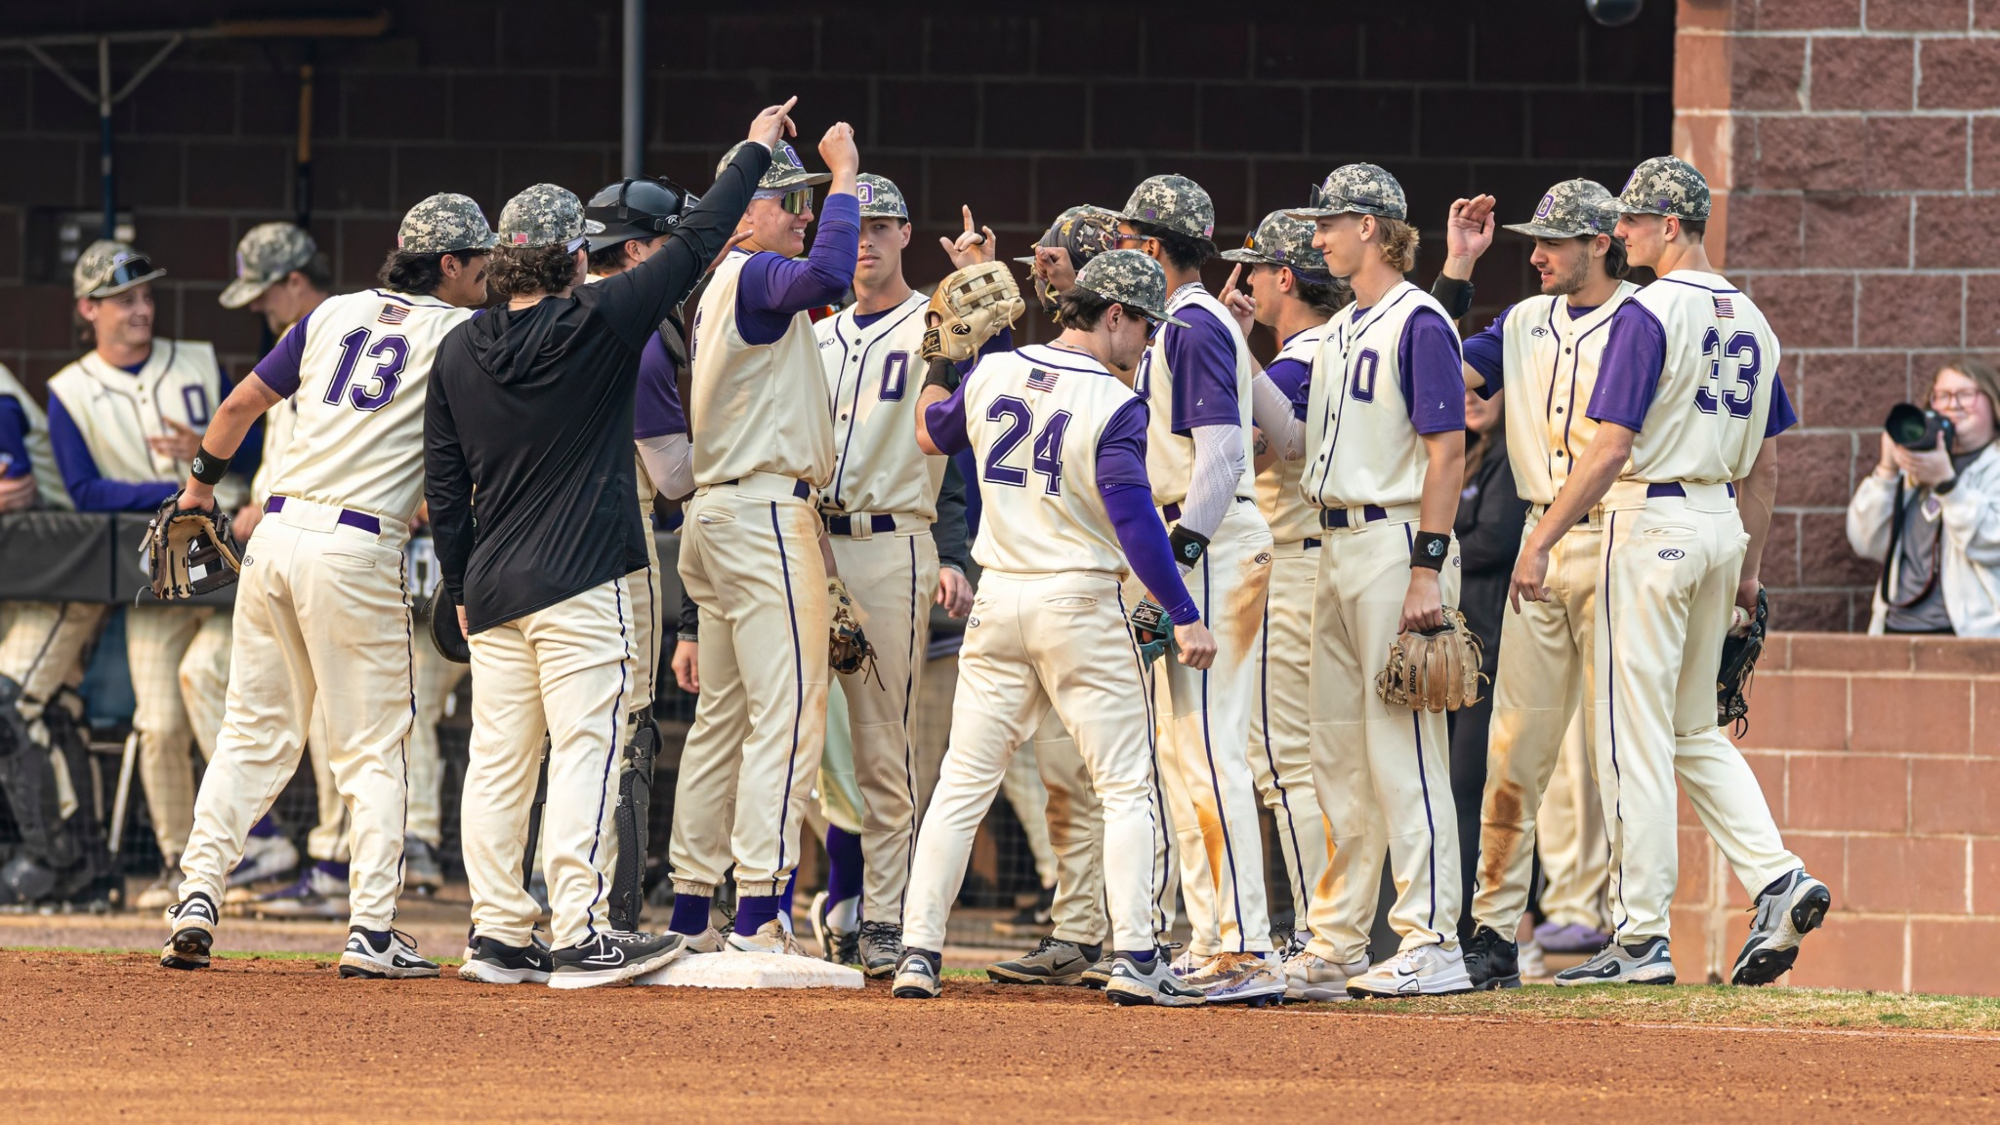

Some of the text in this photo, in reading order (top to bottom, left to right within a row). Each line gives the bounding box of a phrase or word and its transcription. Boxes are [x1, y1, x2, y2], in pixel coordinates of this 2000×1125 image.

[784, 145, 804, 169] O
[857, 183, 874, 205] O
[1535, 193, 1555, 219] O
[322, 326, 411, 412] 13
[878, 349, 909, 402] O
[1349, 347, 1380, 404] O
[1694, 326, 1762, 420] 33
[182, 384, 209, 426] O
[983, 393, 1073, 497] 24
[1409, 664, 1418, 695] A2000
